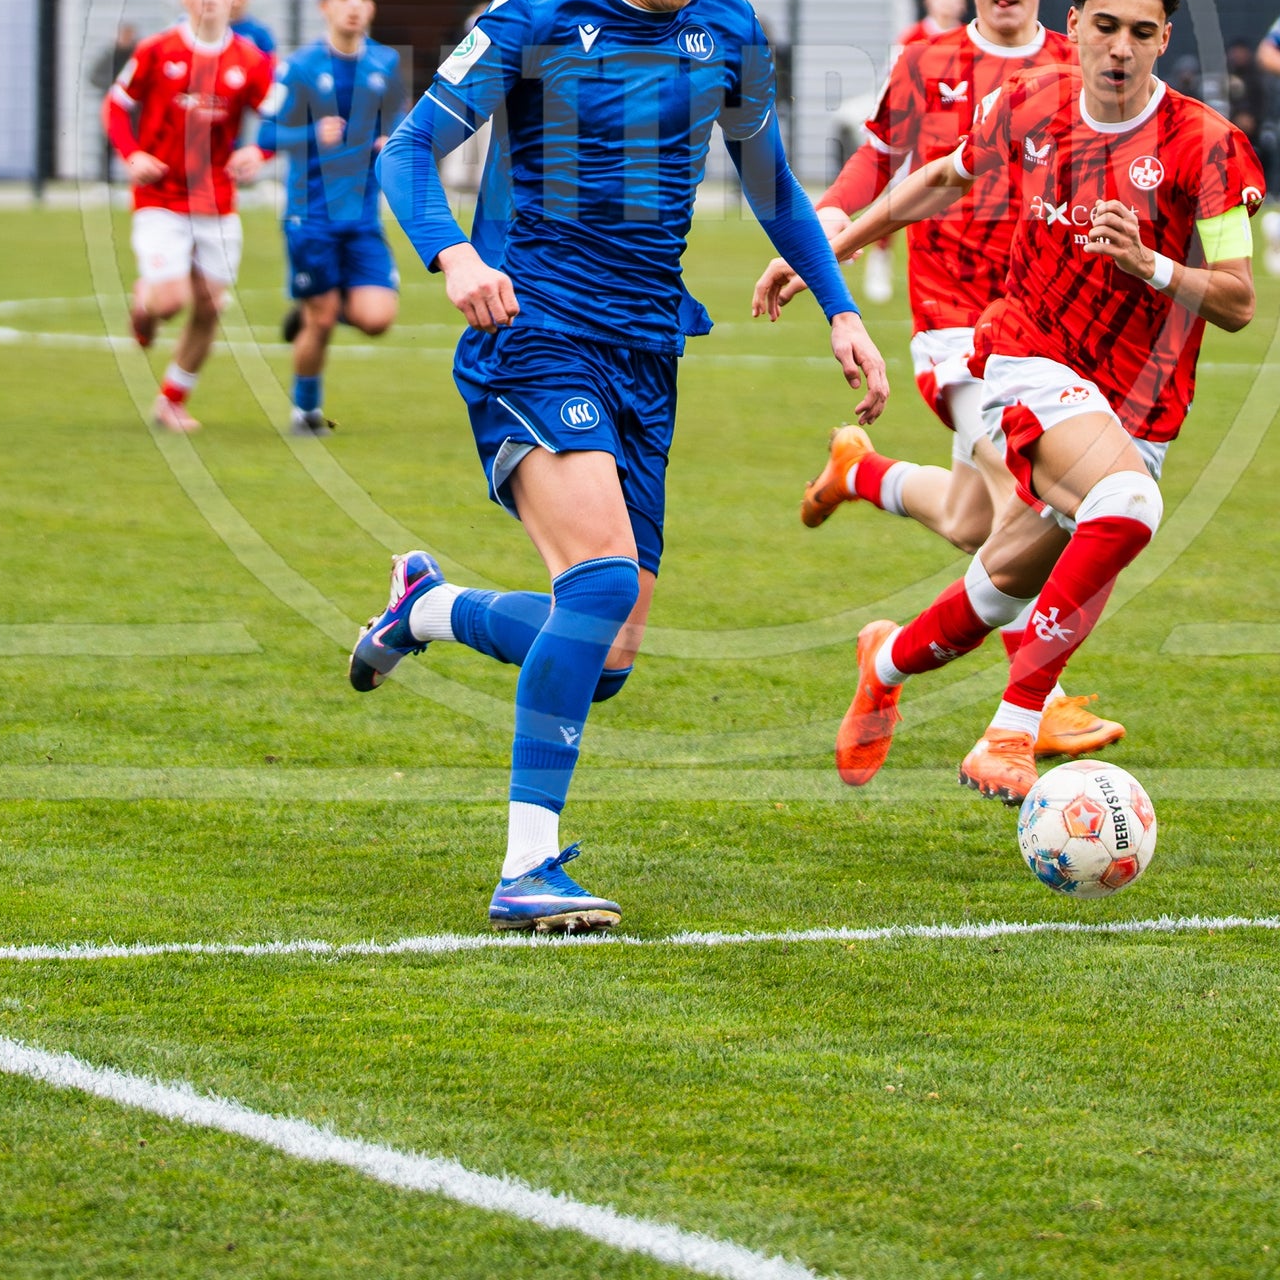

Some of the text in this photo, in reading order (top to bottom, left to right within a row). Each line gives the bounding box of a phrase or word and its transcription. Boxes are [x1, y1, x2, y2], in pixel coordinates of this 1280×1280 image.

[685, 33, 707, 53] KSC
[568, 403, 594, 425] KSC
[1094, 775, 1129, 850] DERBYSTAR
